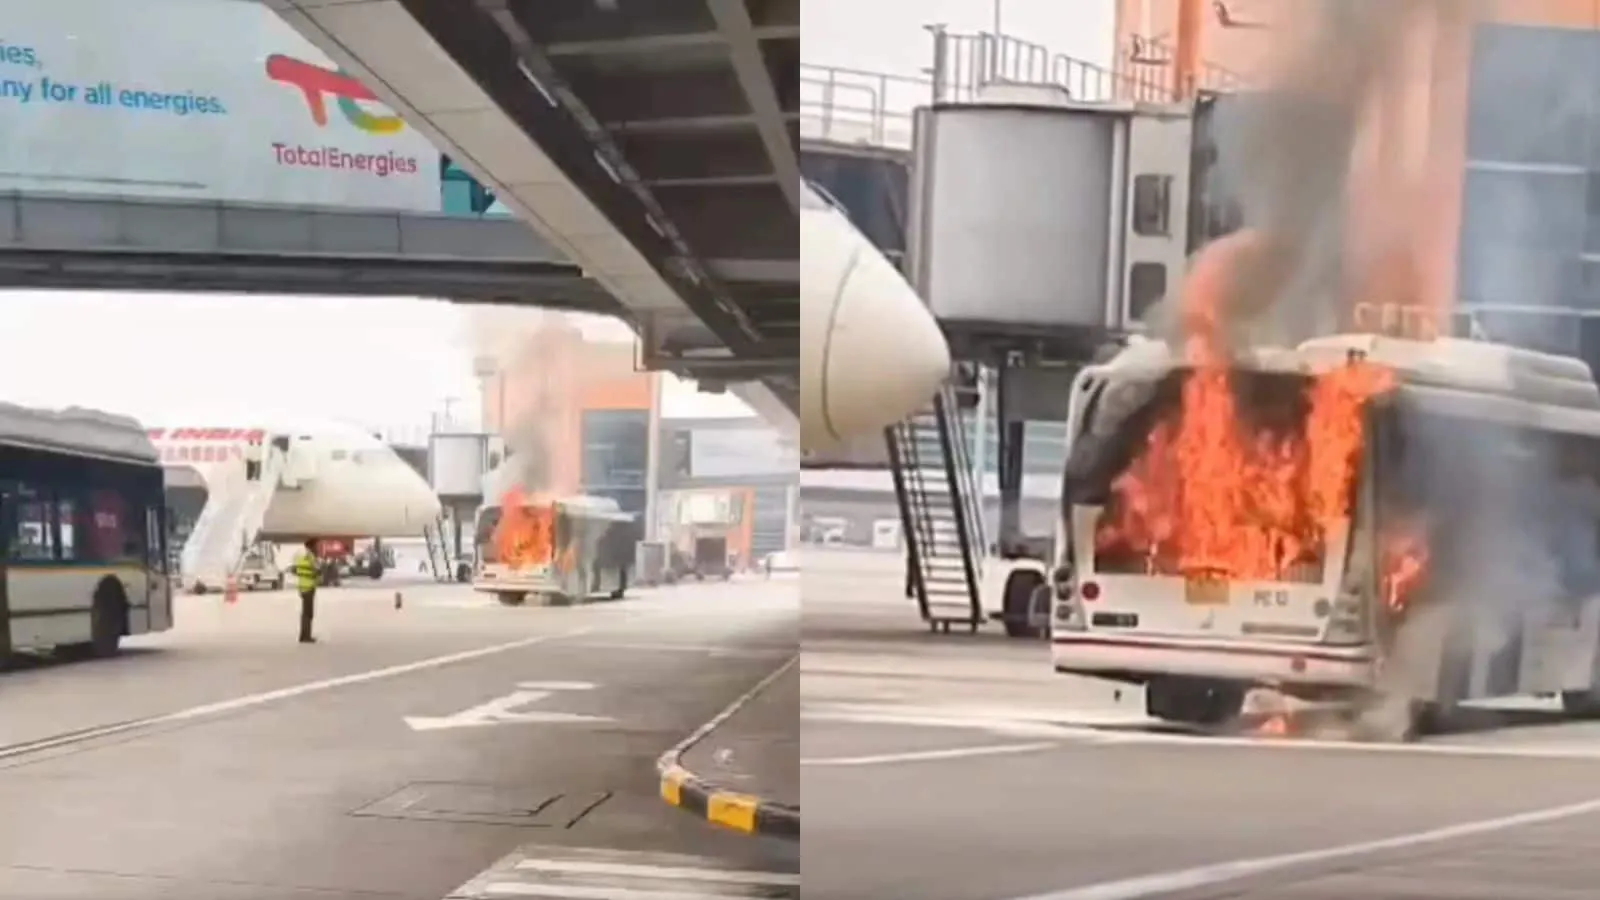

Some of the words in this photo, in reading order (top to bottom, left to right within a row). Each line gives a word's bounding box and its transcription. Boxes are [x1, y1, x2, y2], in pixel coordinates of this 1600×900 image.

[41, 77, 78, 102] for
[84, 82, 111, 105] all
[119, 89, 227, 115] energies.
[271, 142, 417, 177] TotalEnergies
